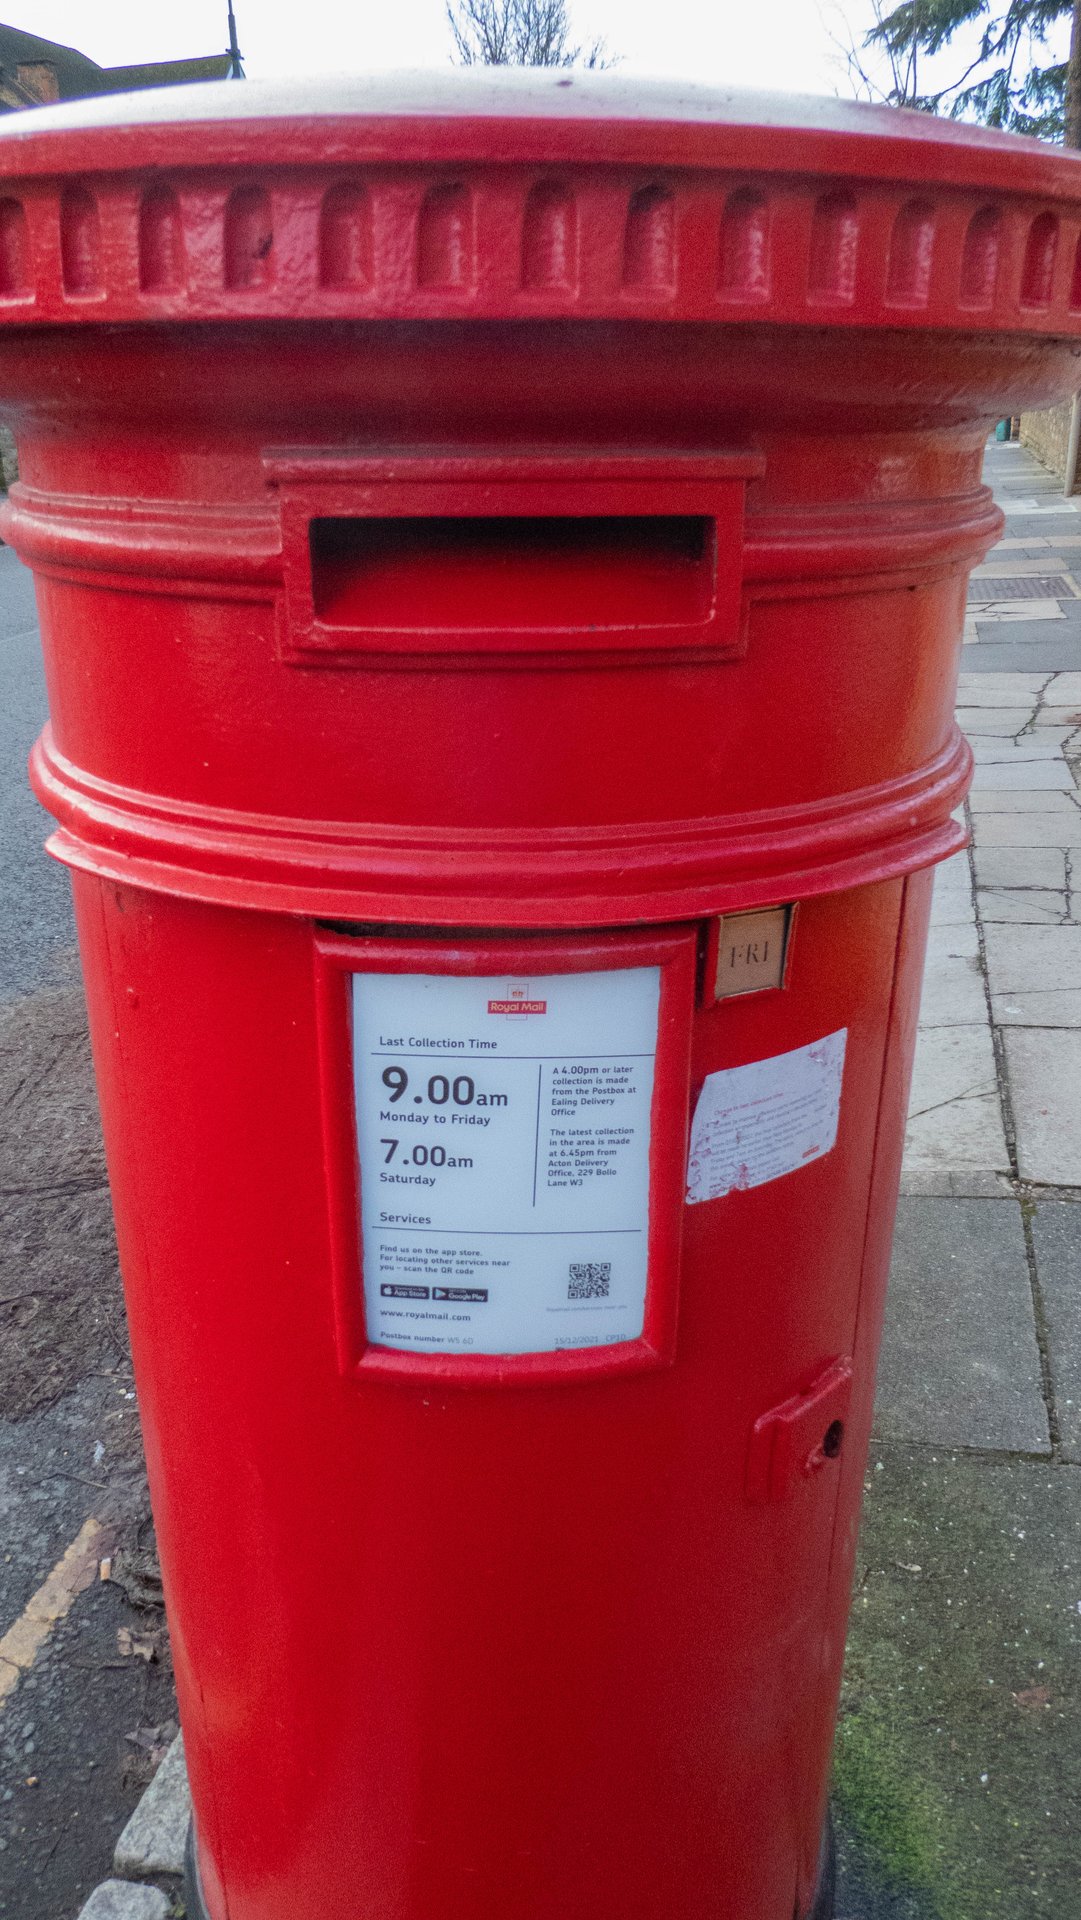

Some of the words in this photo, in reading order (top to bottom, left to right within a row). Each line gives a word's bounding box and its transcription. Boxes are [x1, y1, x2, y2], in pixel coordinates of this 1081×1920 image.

[730, 941, 768, 968] FRI
[491, 1002, 519, 1013] Royal
[521, 1002, 544, 1012] Mail
[380, 1036, 404, 1047] Last
[408, 1037, 465, 1049] Collection
[468, 1039, 498, 1049] Time
[562, 1066, 599, 1076] 4.00pm
[614, 1066, 633, 1074] later
[552, 1077, 593, 1085] collection
[596, 1076, 603, 1085] is
[605, 1076, 629, 1084] made
[382, 1066, 508, 1107] 9.00am
[552, 1088, 573, 1096] from
[592, 1087, 626, 1095] Postbox
[628, 1086, 637, 1094] at
[551, 1098, 578, 1107] Ealing
[580, 1097, 615, 1107] Delivery
[551, 1108, 576, 1116] Office
[380, 1112, 429, 1125] Monday
[434, 1114, 446, 1124] to
[451, 1114, 491, 1127] Friday
[568, 1128, 592, 1136] latest
[595, 1127, 635, 1135] collection
[607, 1137, 630, 1145] made
[380, 1138, 474, 1168] 7.00am
[560, 1148, 594, 1158] 6.45pm
[597, 1148, 617, 1156] from
[548, 1159, 572, 1167] Acton
[574, 1159, 608, 1168] Delivery
[596, 1168, 617, 1176] Bollo
[380, 1173, 436, 1186] Saturday
[548, 1179, 567, 1187] Lane
[570, 1178, 583, 1186] W3
[380, 1212, 432, 1225] Services
[380, 1244, 397, 1253] Find
[425, 1247, 439, 1255] the
[442, 1249, 457, 1257] app
[459, 1249, 483, 1257] store.
[380, 1254, 393, 1262] For
[396, 1255, 428, 1265] locating
[431, 1257, 453, 1265] other
[456, 1258, 489, 1266] services
[380, 1265, 394, 1273] you
[425, 1266, 438, 1274] the
[441, 1266, 453, 1275] QR
[456, 1267, 474, 1275] code
[394, 1290, 408, 1298] App
[409, 1290, 427, 1298] Store
[448, 1292, 471, 1301] Google
[471, 1292, 486, 1302] Play
[380, 1310, 471, 1322] www.royalmail.com
[380, 1332, 411, 1341] Postbox
[414, 1334, 445, 1343] number
